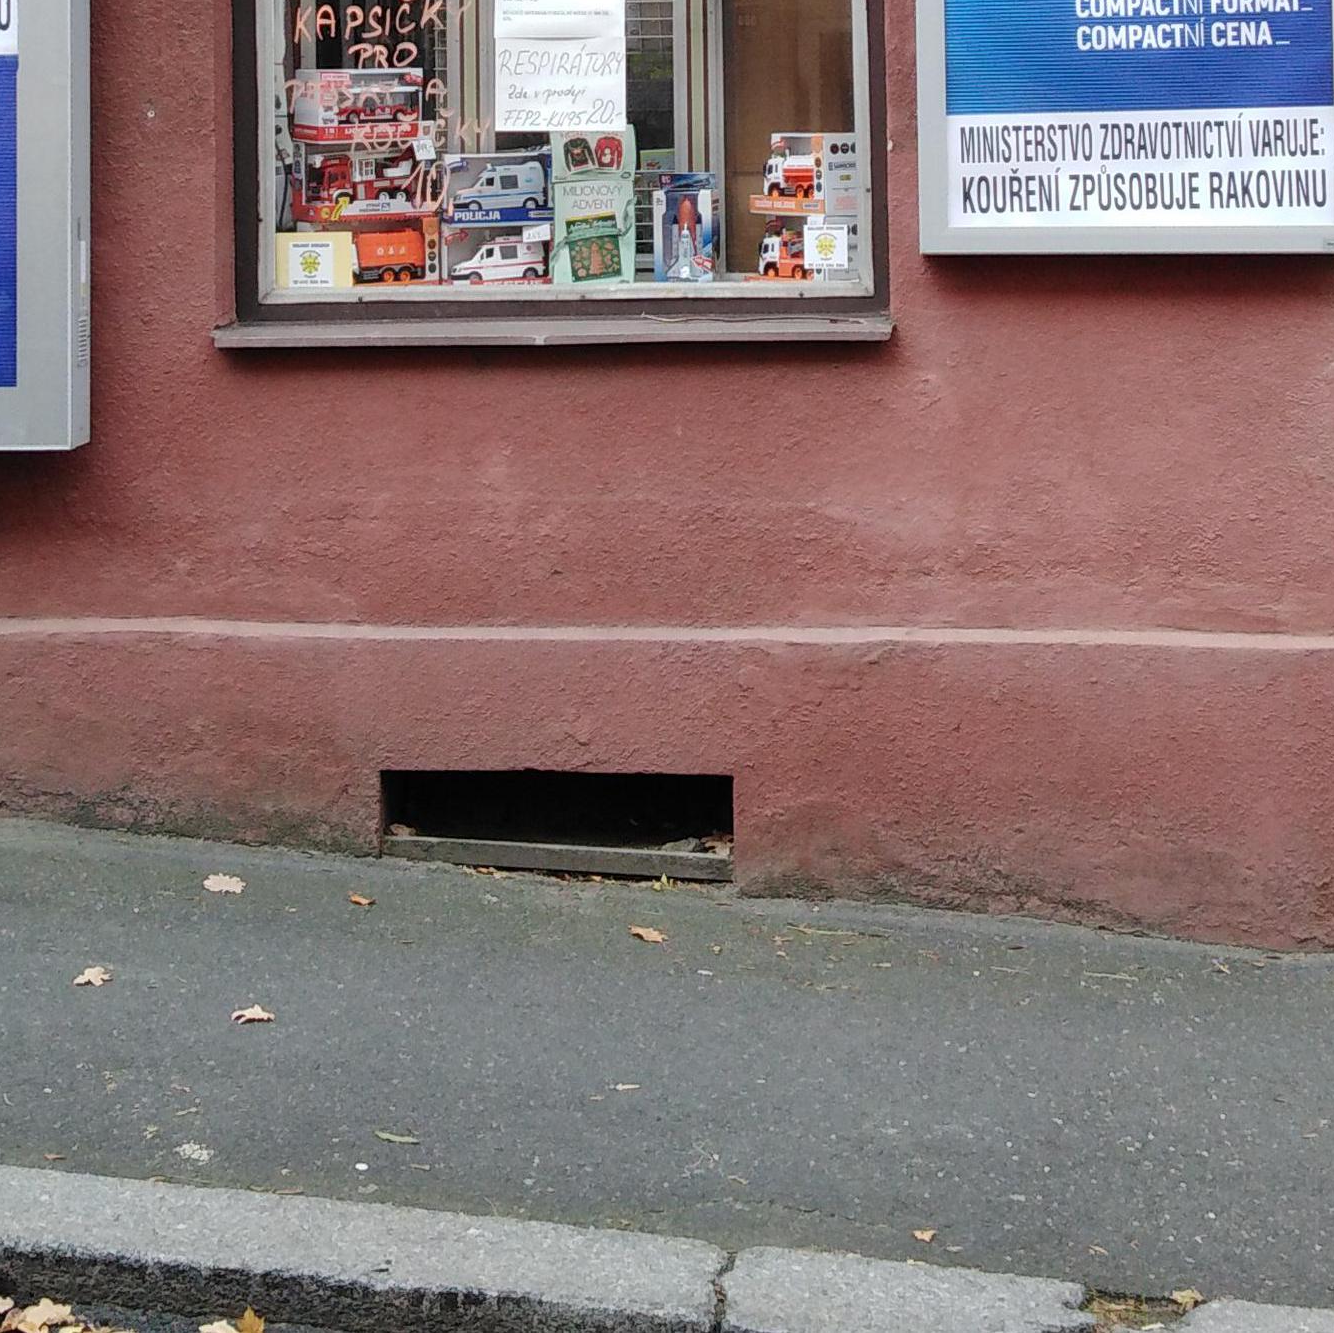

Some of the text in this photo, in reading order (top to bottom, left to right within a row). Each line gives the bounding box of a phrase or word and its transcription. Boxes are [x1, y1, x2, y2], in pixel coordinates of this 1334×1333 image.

[1077, 18, 1205, 51] COMPACTNÍ
[348, 42, 418, 68] PRO
[498, 43, 624, 77] RESPIRÁTORY
[960, 113, 1325, 164] MINISTERSTVO ZDRAVOTNICTVÍ VARUJE:
[962, 164, 1327, 214] KOUŘENÍ ZPŮSOBUJE RAKOVINU
[454, 211, 501, 221] POLICJA
